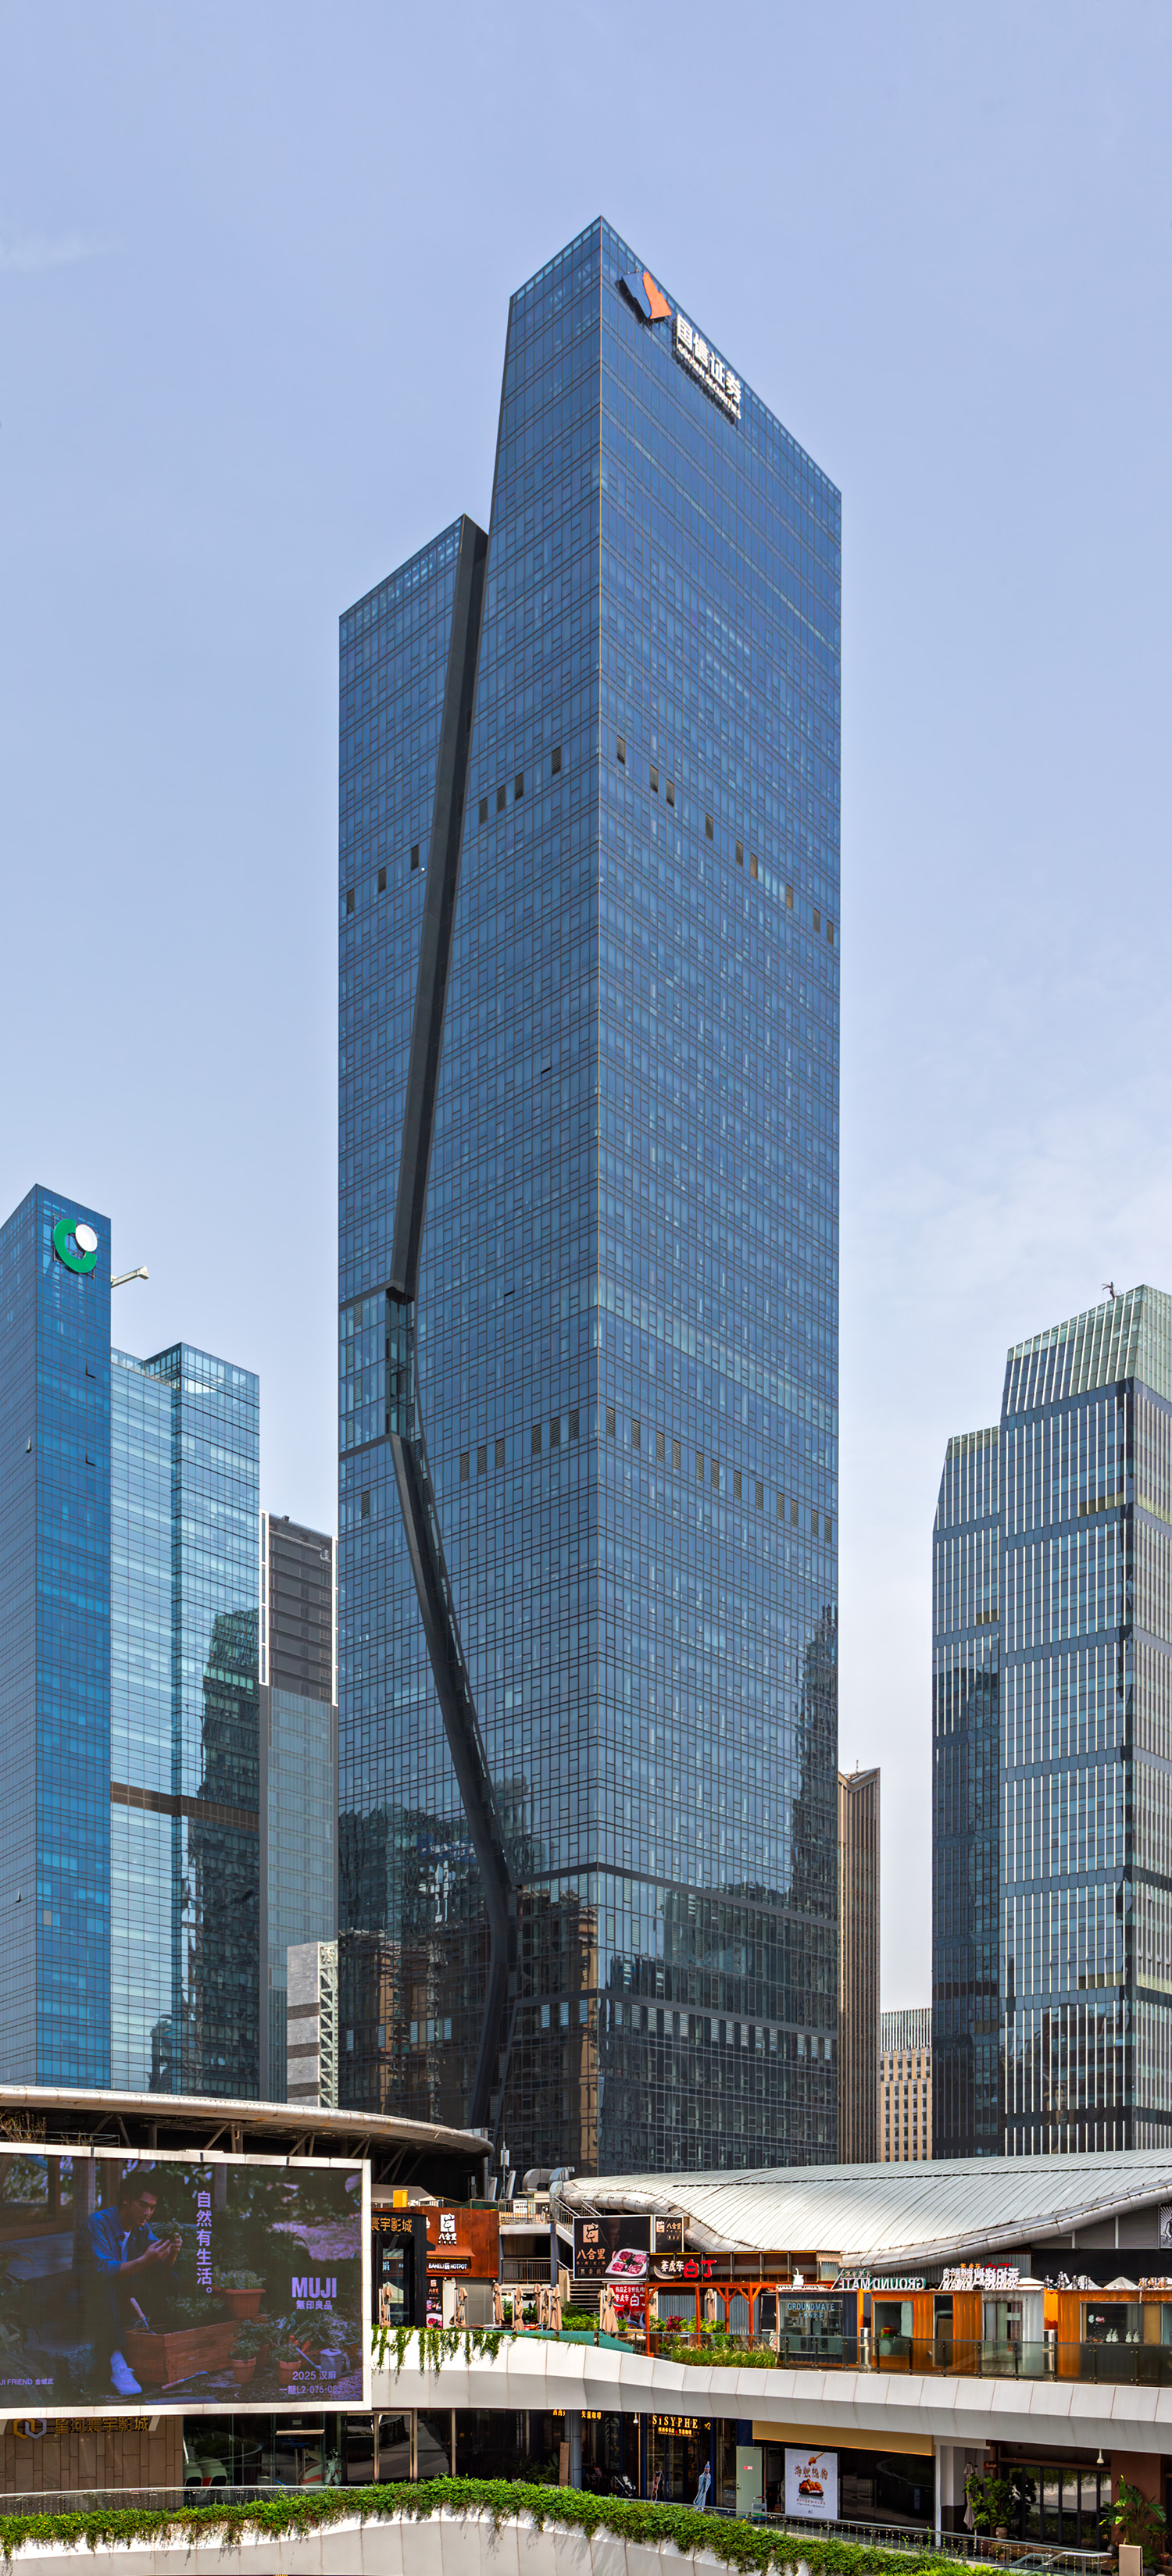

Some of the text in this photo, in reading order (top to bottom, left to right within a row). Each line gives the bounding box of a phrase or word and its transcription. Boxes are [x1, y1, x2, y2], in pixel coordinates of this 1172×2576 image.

[196, 2190, 213, 2293] 自然有生活。
[577, 2248, 606, 2260] 八合里
[291, 2277, 337, 2299] MUJI
[295, 2299, 333, 2310] 無印良品
[788, 2303, 834, 2311] GROUNDMATE
[292, 2371, 337, 2381] 2025 汉麻
[54, 2416, 149, 2434] 星河寰宇影城
